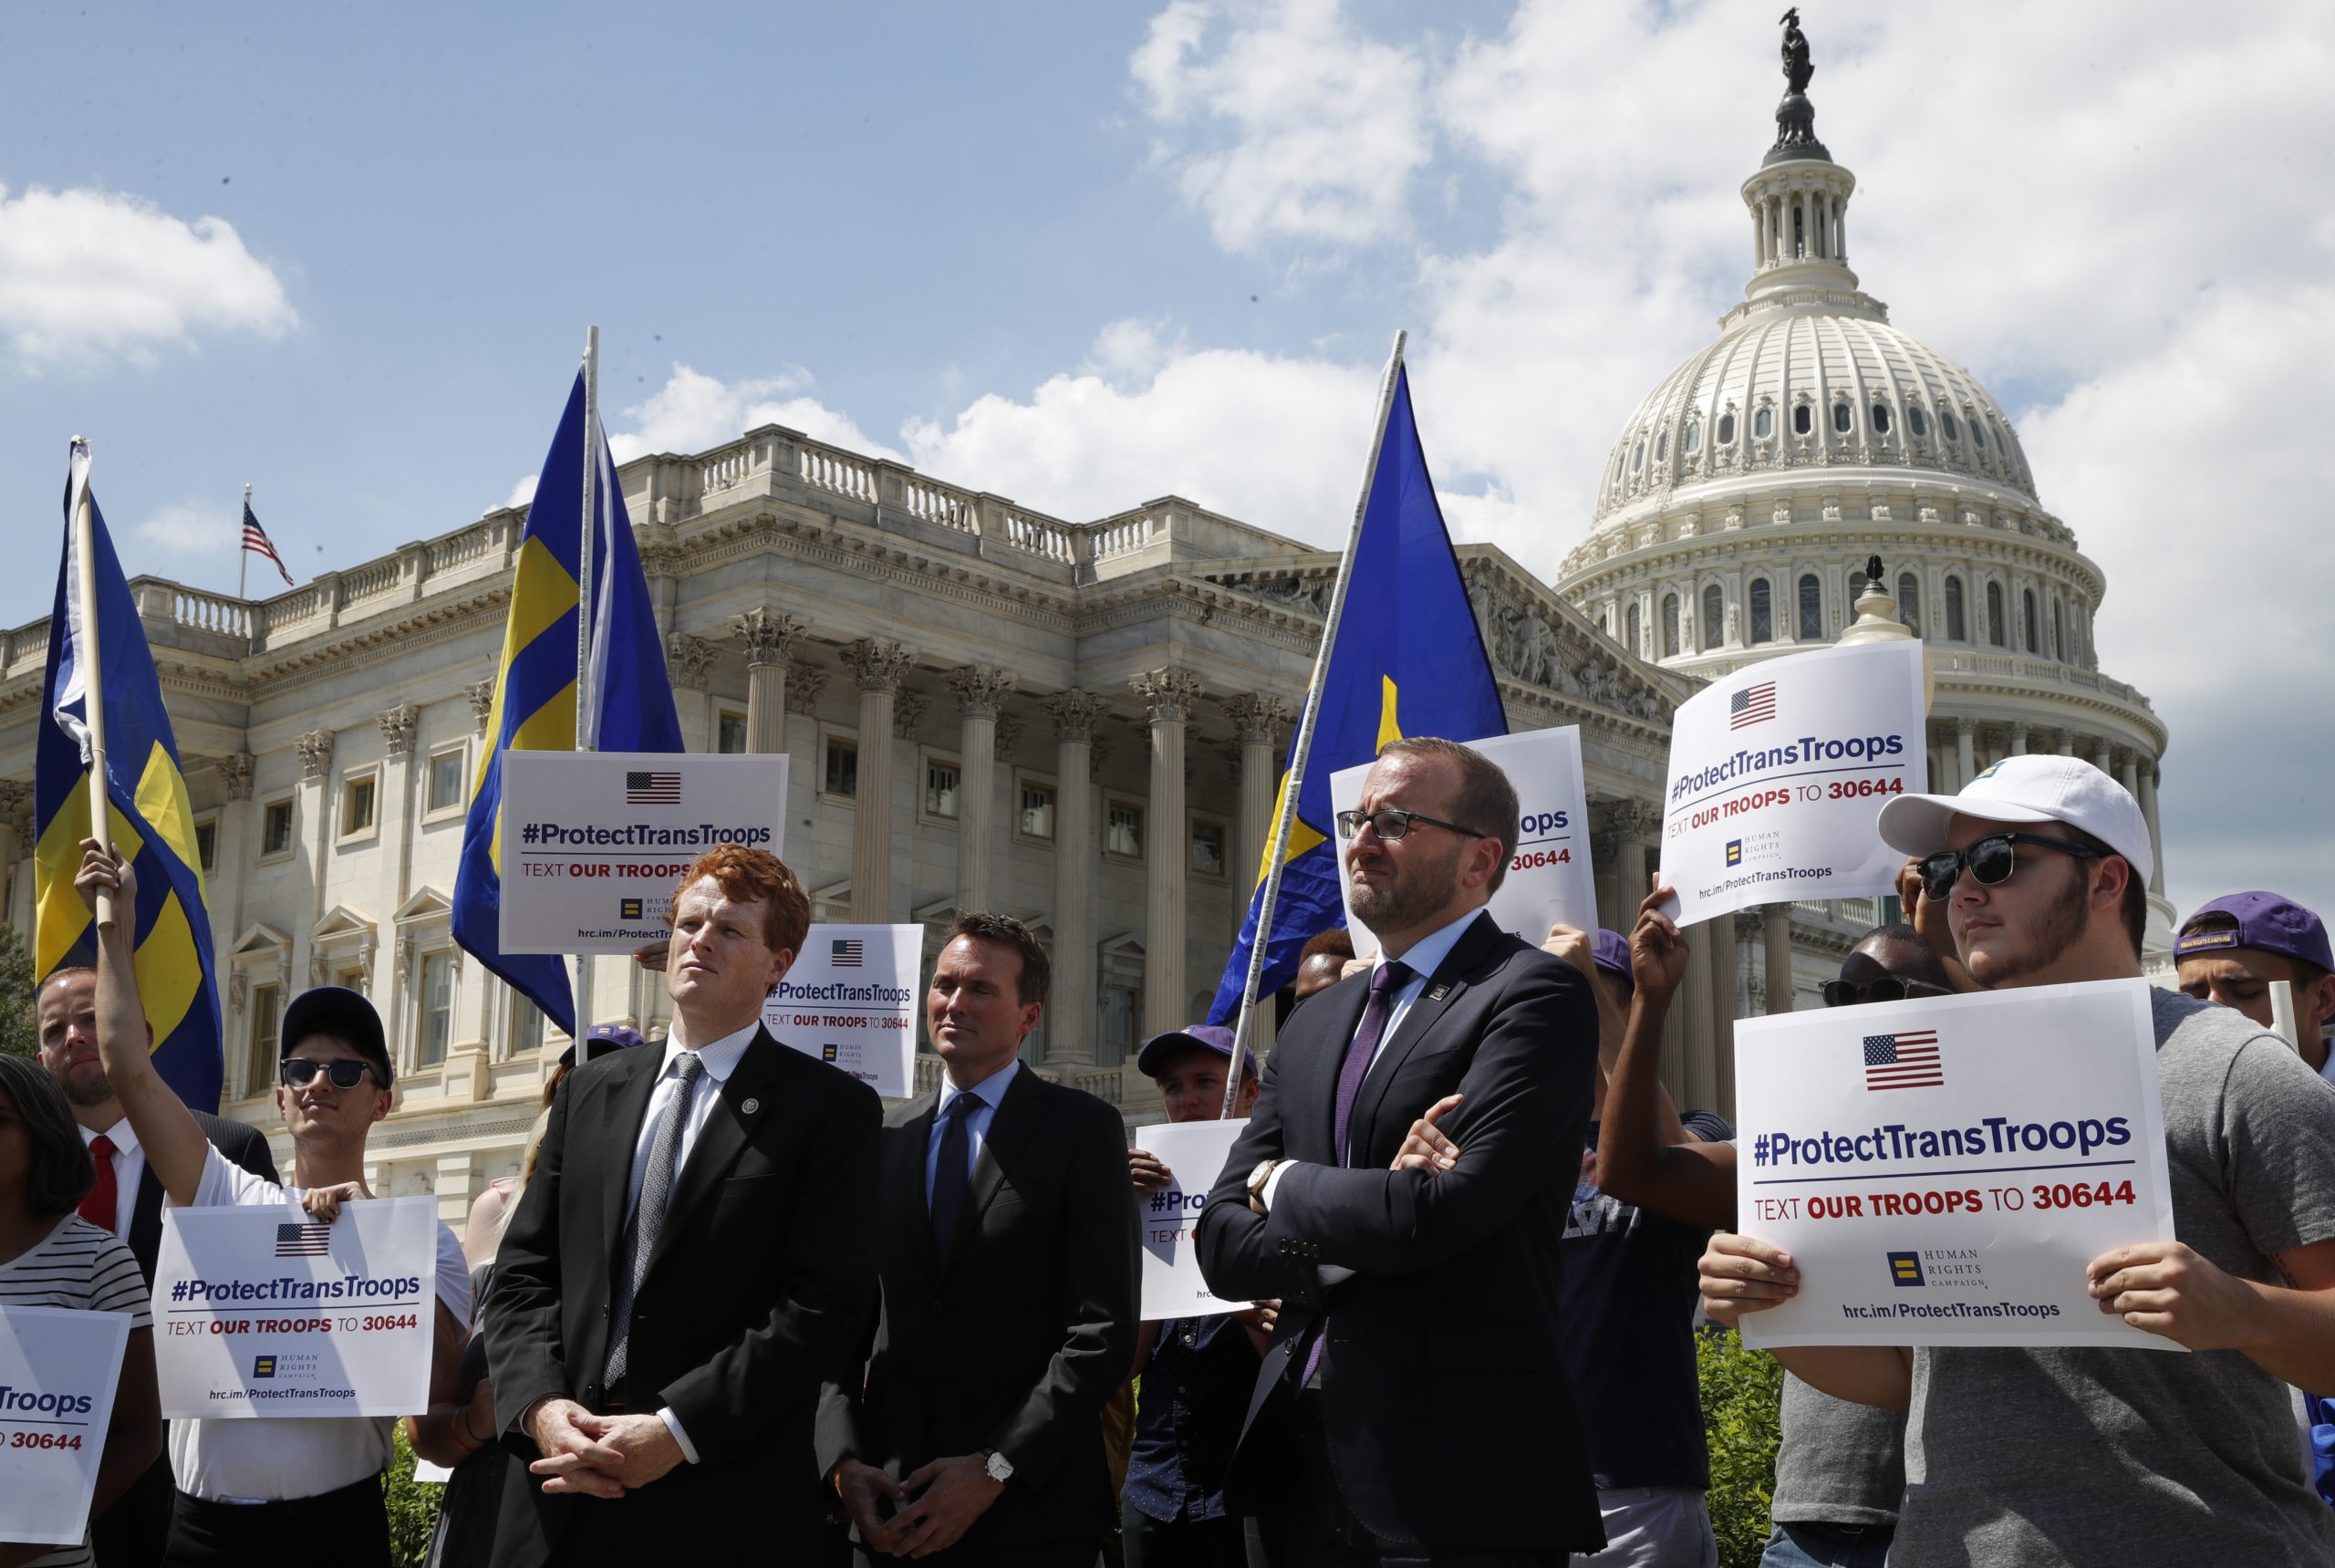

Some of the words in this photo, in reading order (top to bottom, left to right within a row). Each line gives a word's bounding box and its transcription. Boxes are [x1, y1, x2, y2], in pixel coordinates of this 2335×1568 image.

[1671, 734, 1904, 805] #ProtectTransTroops
[1667, 817, 1689, 840] TEXT
[1691, 806, 1718, 830] OUR
[1722, 788, 1790, 819] TROOPS
[1796, 784, 1821, 803] TO
[1828, 777, 1904, 799] 30644
[522, 824, 770, 846] #ProtectTransTroops
[1745, 831, 1780, 843] HUMAN
[1745, 842, 1780, 854] RIGHTS
[1510, 848, 1571, 871] 30644
[1744, 852, 1780, 863] CAMPAIGN
[523, 863, 564, 877] TEXT
[569, 864, 611, 877] OUR
[616, 864, 691, 877] TROOPS
[1699, 867, 1832, 899] hrc.im/ProtectTransTroops
[578, 929, 672, 940] hrc.im/ProtectTr
[1221, 1074, 1240, 1120] EAGLE
[1249, 937, 1266, 981] SCH40
[1261, 895, 1273, 931] PVC1120
[1281, 805, 1292, 836] ASTM
[767, 1013, 791, 1025] TEXT
[794, 1014, 818, 1026] OUR
[823, 1015, 867, 1028] TROOPS
[870, 1017, 879, 1029] TO
[881, 1017, 908, 1029] 30644
[1754, 1116, 2131, 1168] #ProtectTransTroops
[1754, 1198, 1801, 1220] TEXT
[1807, 1194, 1863, 1220] OUR
[1868, 1189, 1983, 1217] TROOPS
[1988, 1187, 2024, 1211] TO
[2032, 1180, 2136, 1210] 30644
[1150, 1229, 1187, 1243] TEXT
[1925, 1250, 1978, 1260] HUMAN
[1928, 1264, 1981, 1275] RIGHTS
[171, 1275, 420, 1302] #ProtectTransTroops
[1931, 1279, 1985, 1288] CAMPAIGN
[1842, 1303, 2060, 1320] hrc.im/ProtectTransTroops
[168, 1321, 205, 1335] TEXT
[210, 1320, 249, 1334] OUR
[256, 1318, 332, 1334] TROOPS
[337, 1317, 358, 1332] TO
[362, 1314, 417, 1332] 30644
[210, 1387, 356, 1399] hrc.im/ProtectTransTroops
[11, 1431, 82, 1450] 30644
